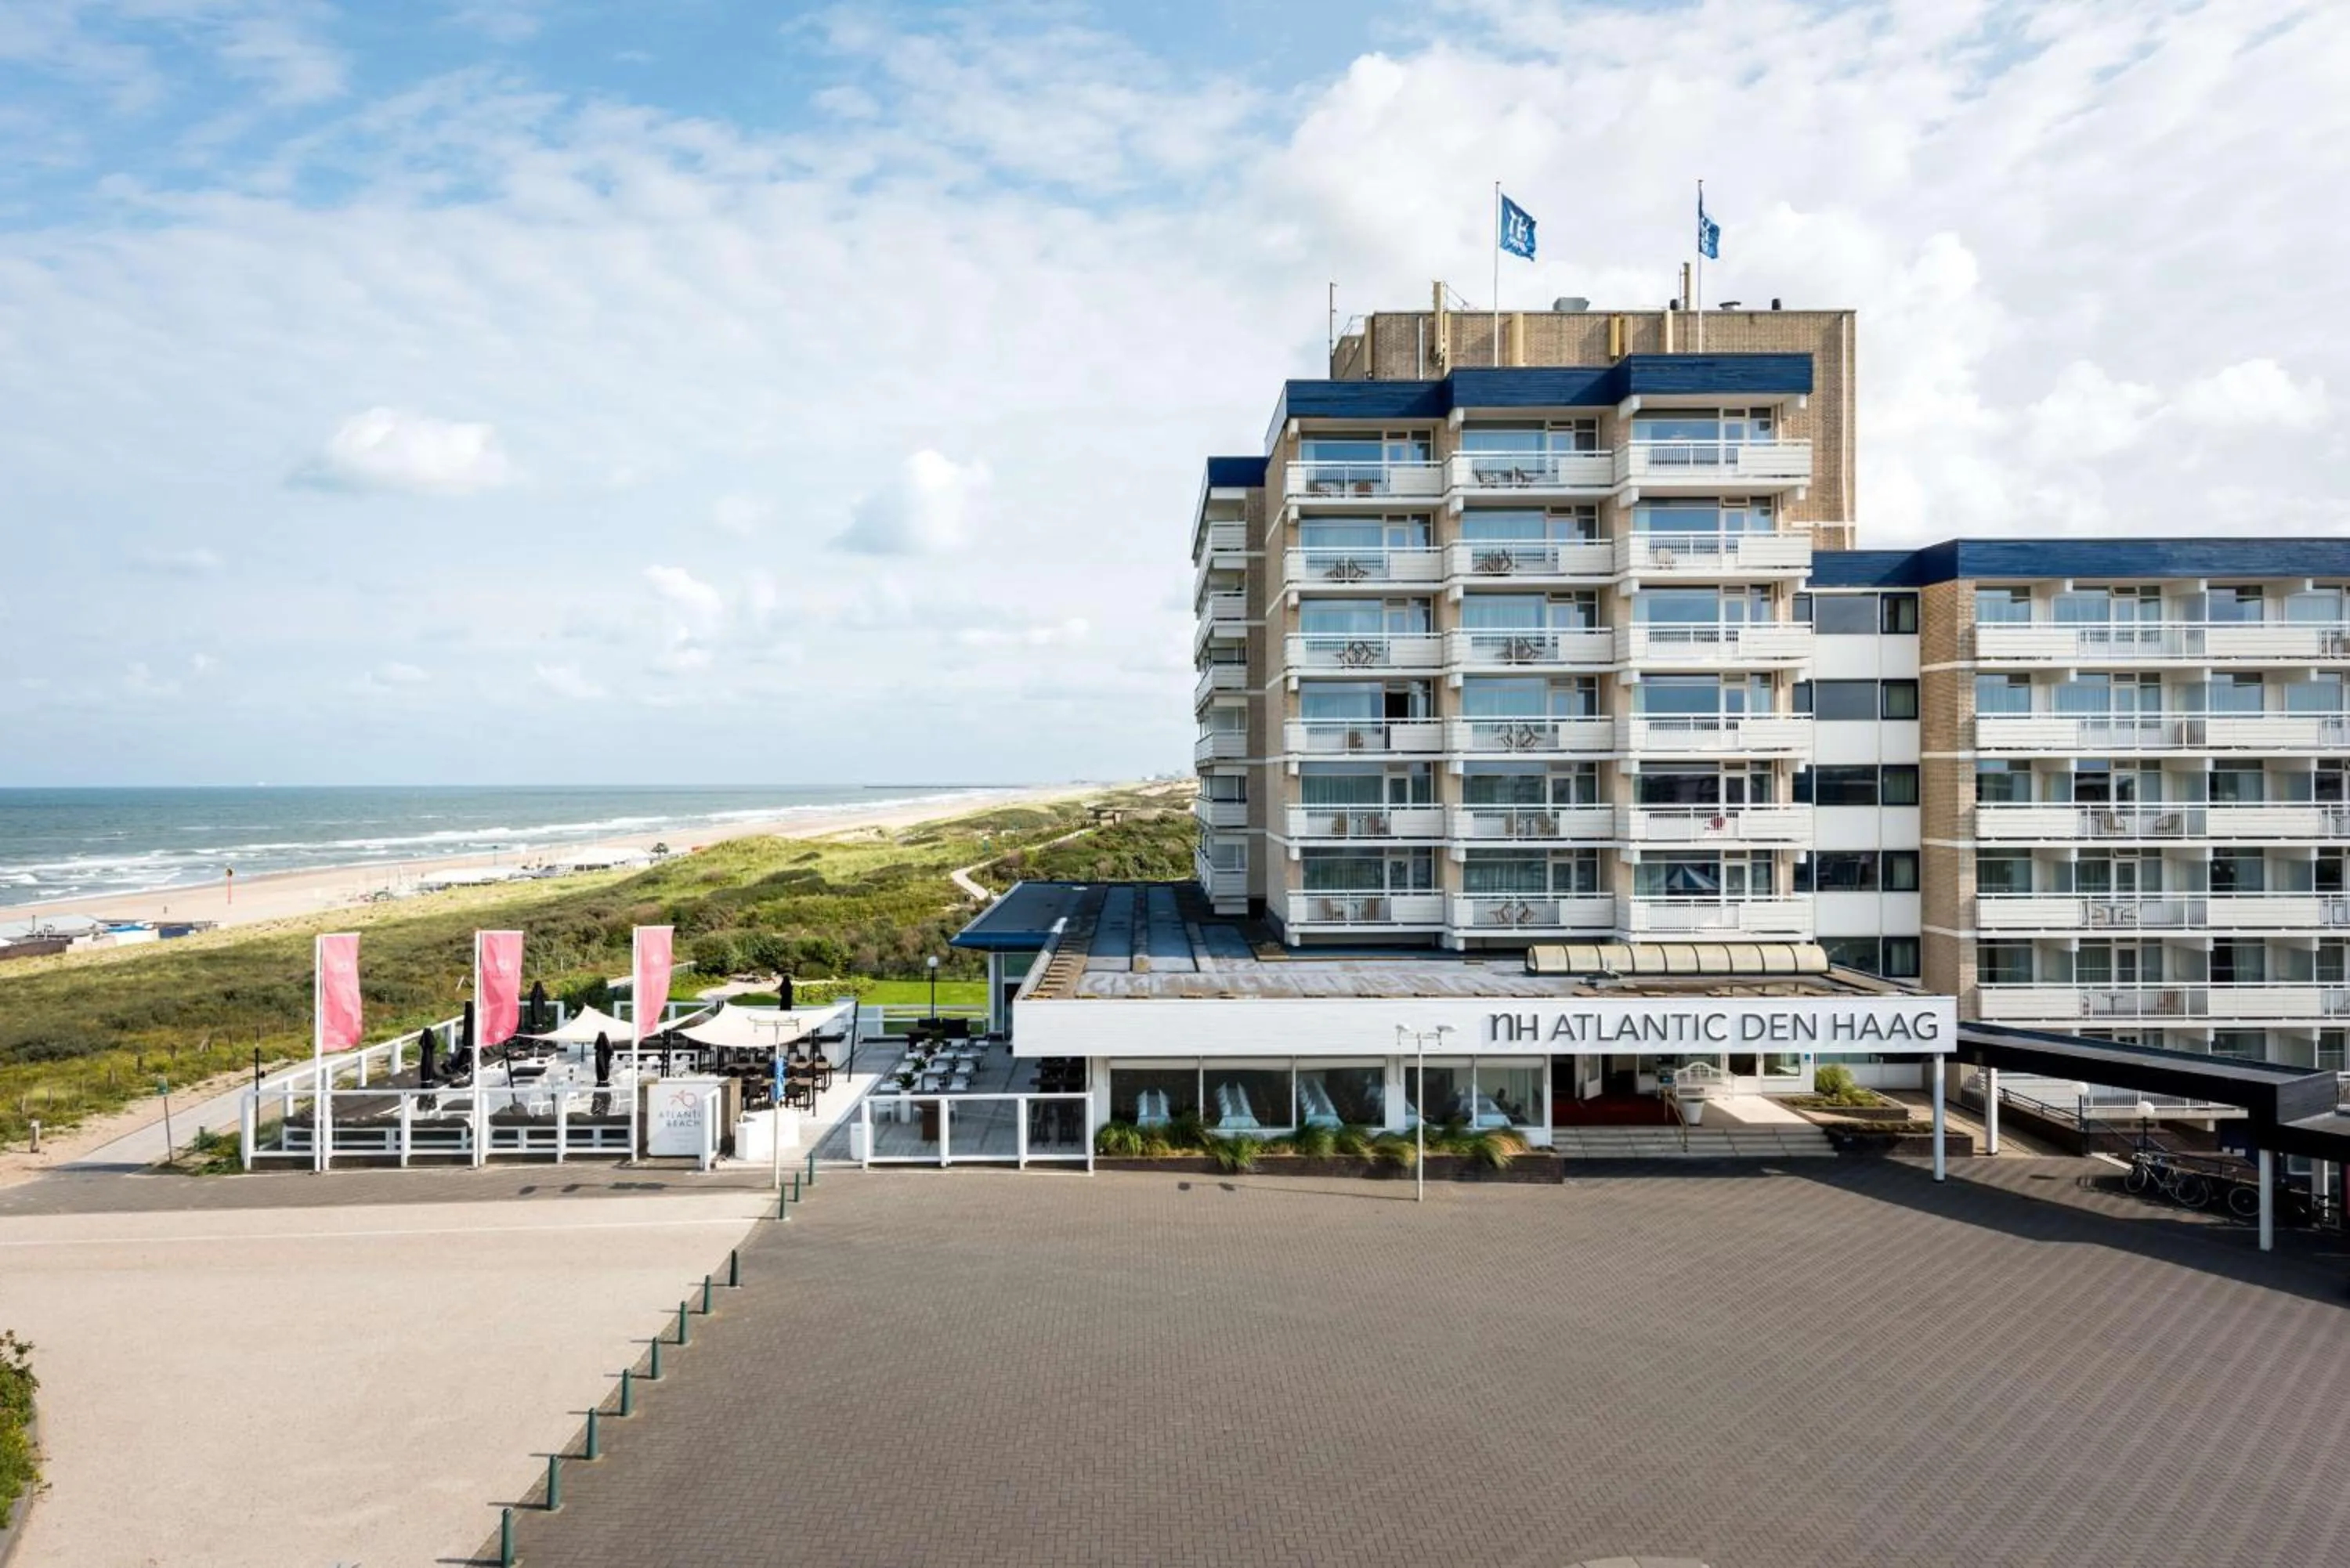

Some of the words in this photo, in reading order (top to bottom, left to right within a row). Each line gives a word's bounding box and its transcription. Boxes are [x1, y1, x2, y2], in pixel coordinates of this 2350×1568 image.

[1549, 1013, 1728, 1042] ATLANTIC
[1741, 1013, 1817, 1041] DEN
[1831, 1011, 1940, 1041] HAAG
[658, 1109, 701, 1118] ATLANTI
